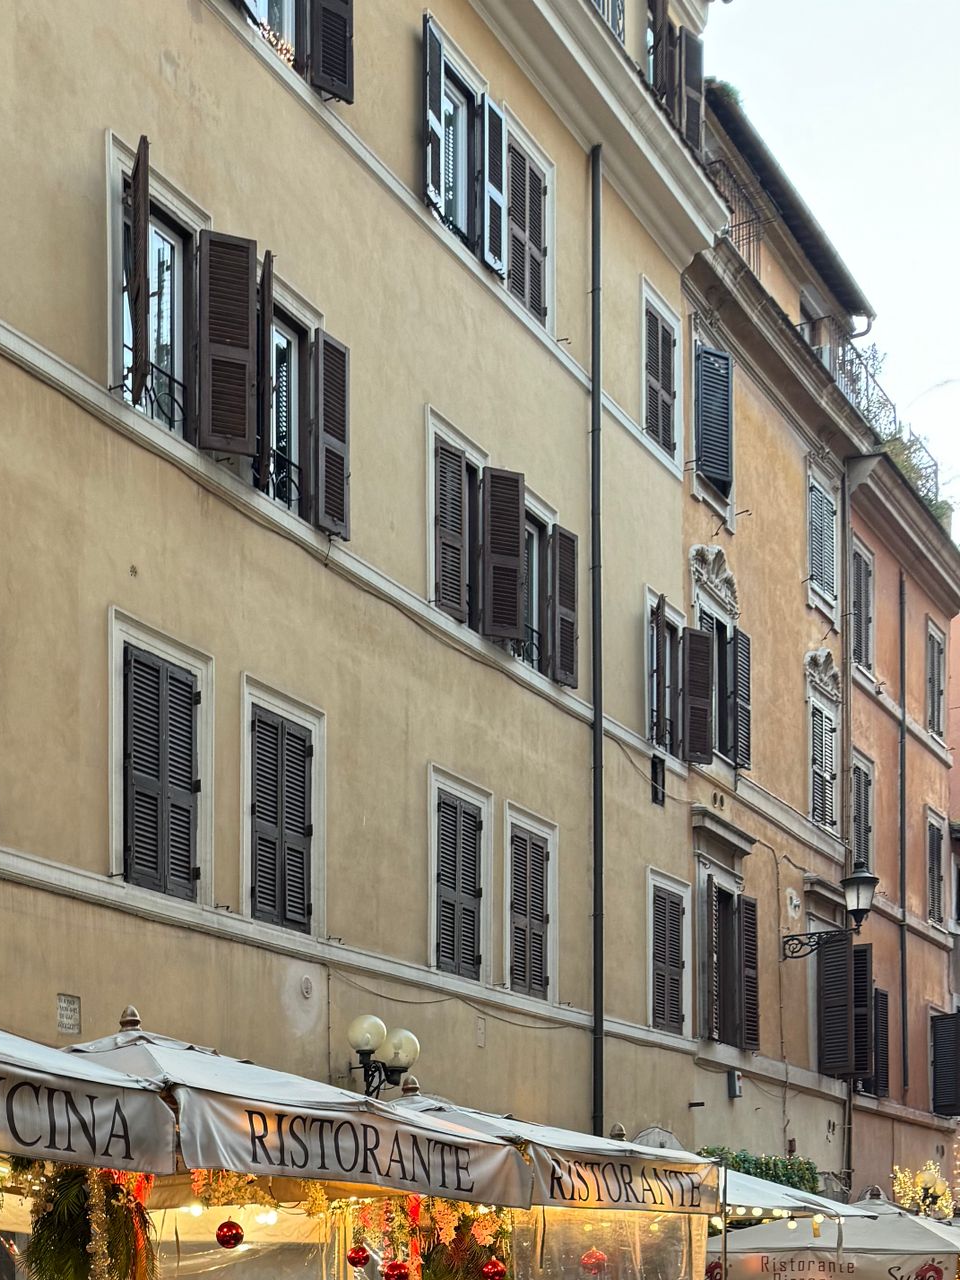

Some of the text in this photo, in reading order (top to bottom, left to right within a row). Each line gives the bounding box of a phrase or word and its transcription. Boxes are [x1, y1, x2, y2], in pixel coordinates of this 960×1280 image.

[245, 1110, 475, 1193] RISTORANTE
[550, 1159, 703, 1208] RISTORANTE
[761, 1255, 855, 1274] Ristorante
